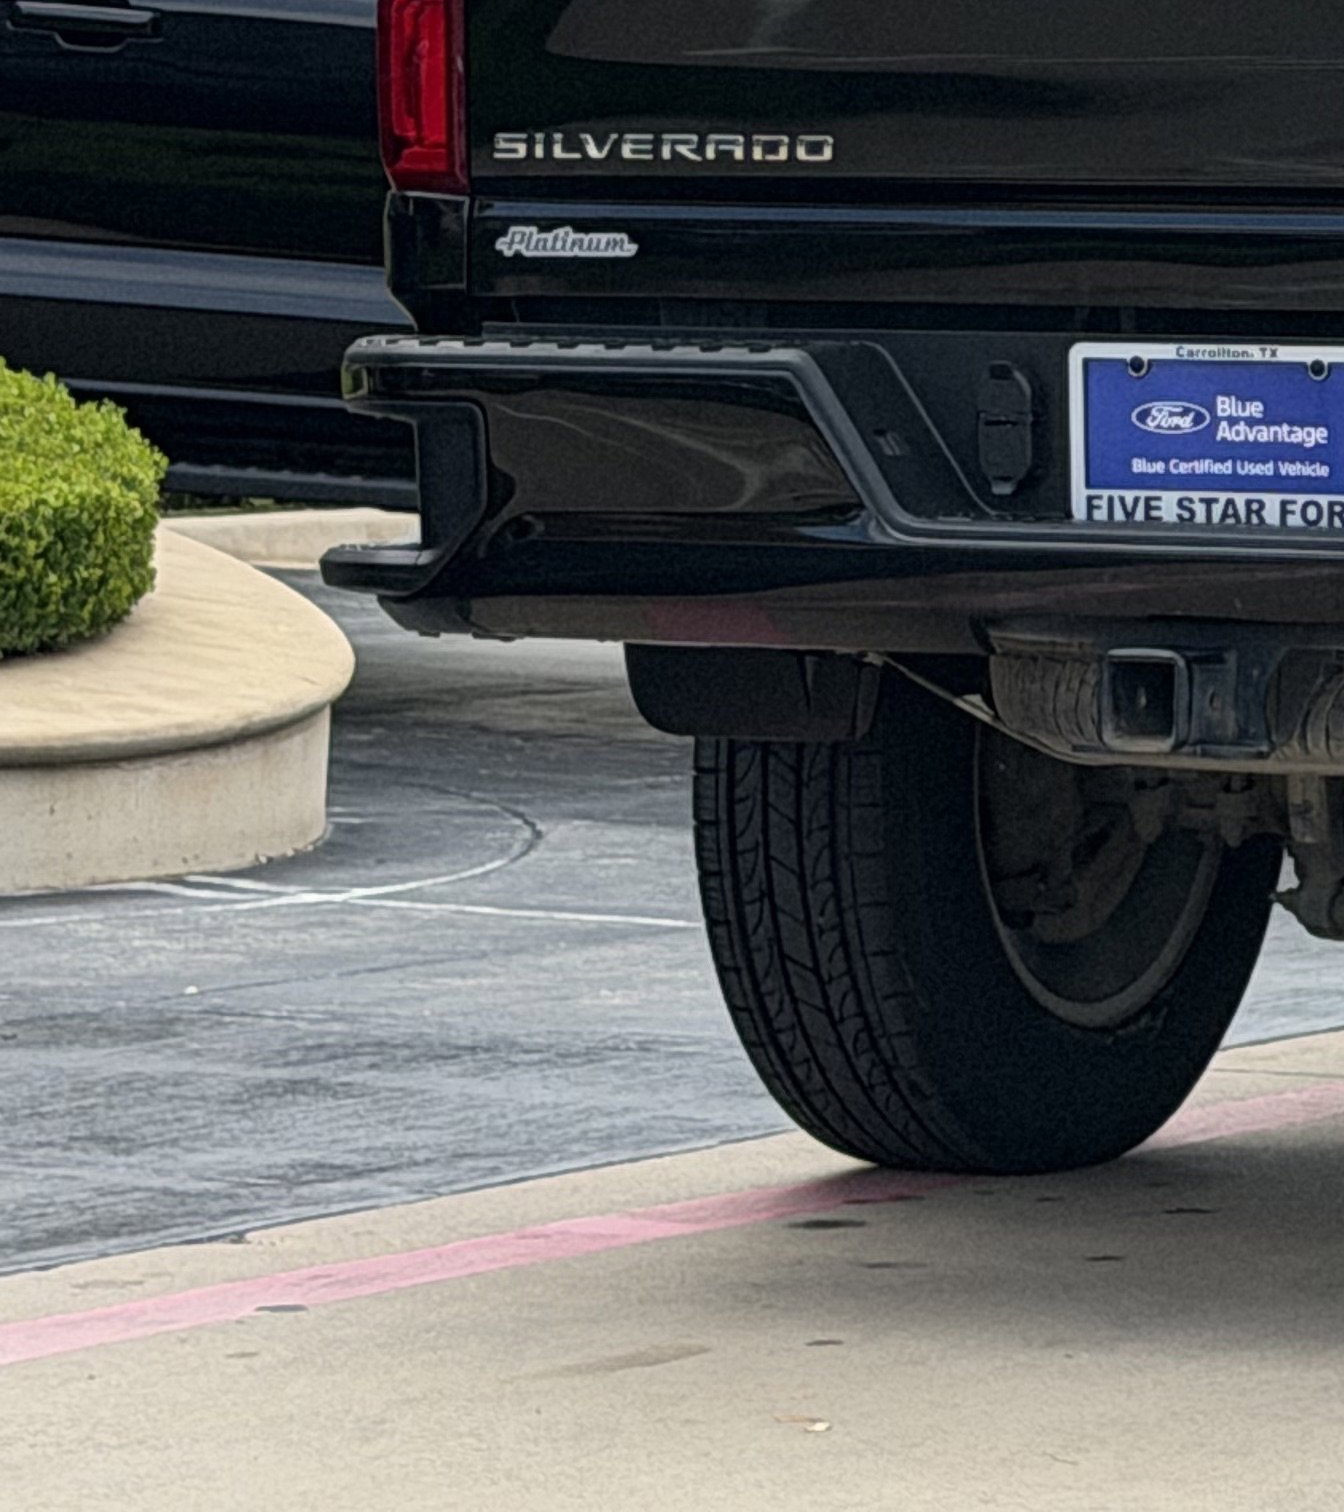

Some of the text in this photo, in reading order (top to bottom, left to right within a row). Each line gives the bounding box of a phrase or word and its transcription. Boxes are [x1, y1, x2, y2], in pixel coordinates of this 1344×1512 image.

[493, 131, 834, 162] SILVERADO
[498, 227, 637, 255] Platinum
[1258, 346, 1279, 359] TX
[1144, 405, 1197, 431] Ford
[1215, 394, 1265, 419] Blue
[1215, 421, 1330, 448] Advantage
[1131, 457, 1331, 478] Blue Certified Used Vehicle
[1085, 494, 1164, 522] FIVE
[1175, 496, 1267, 526] STAR
